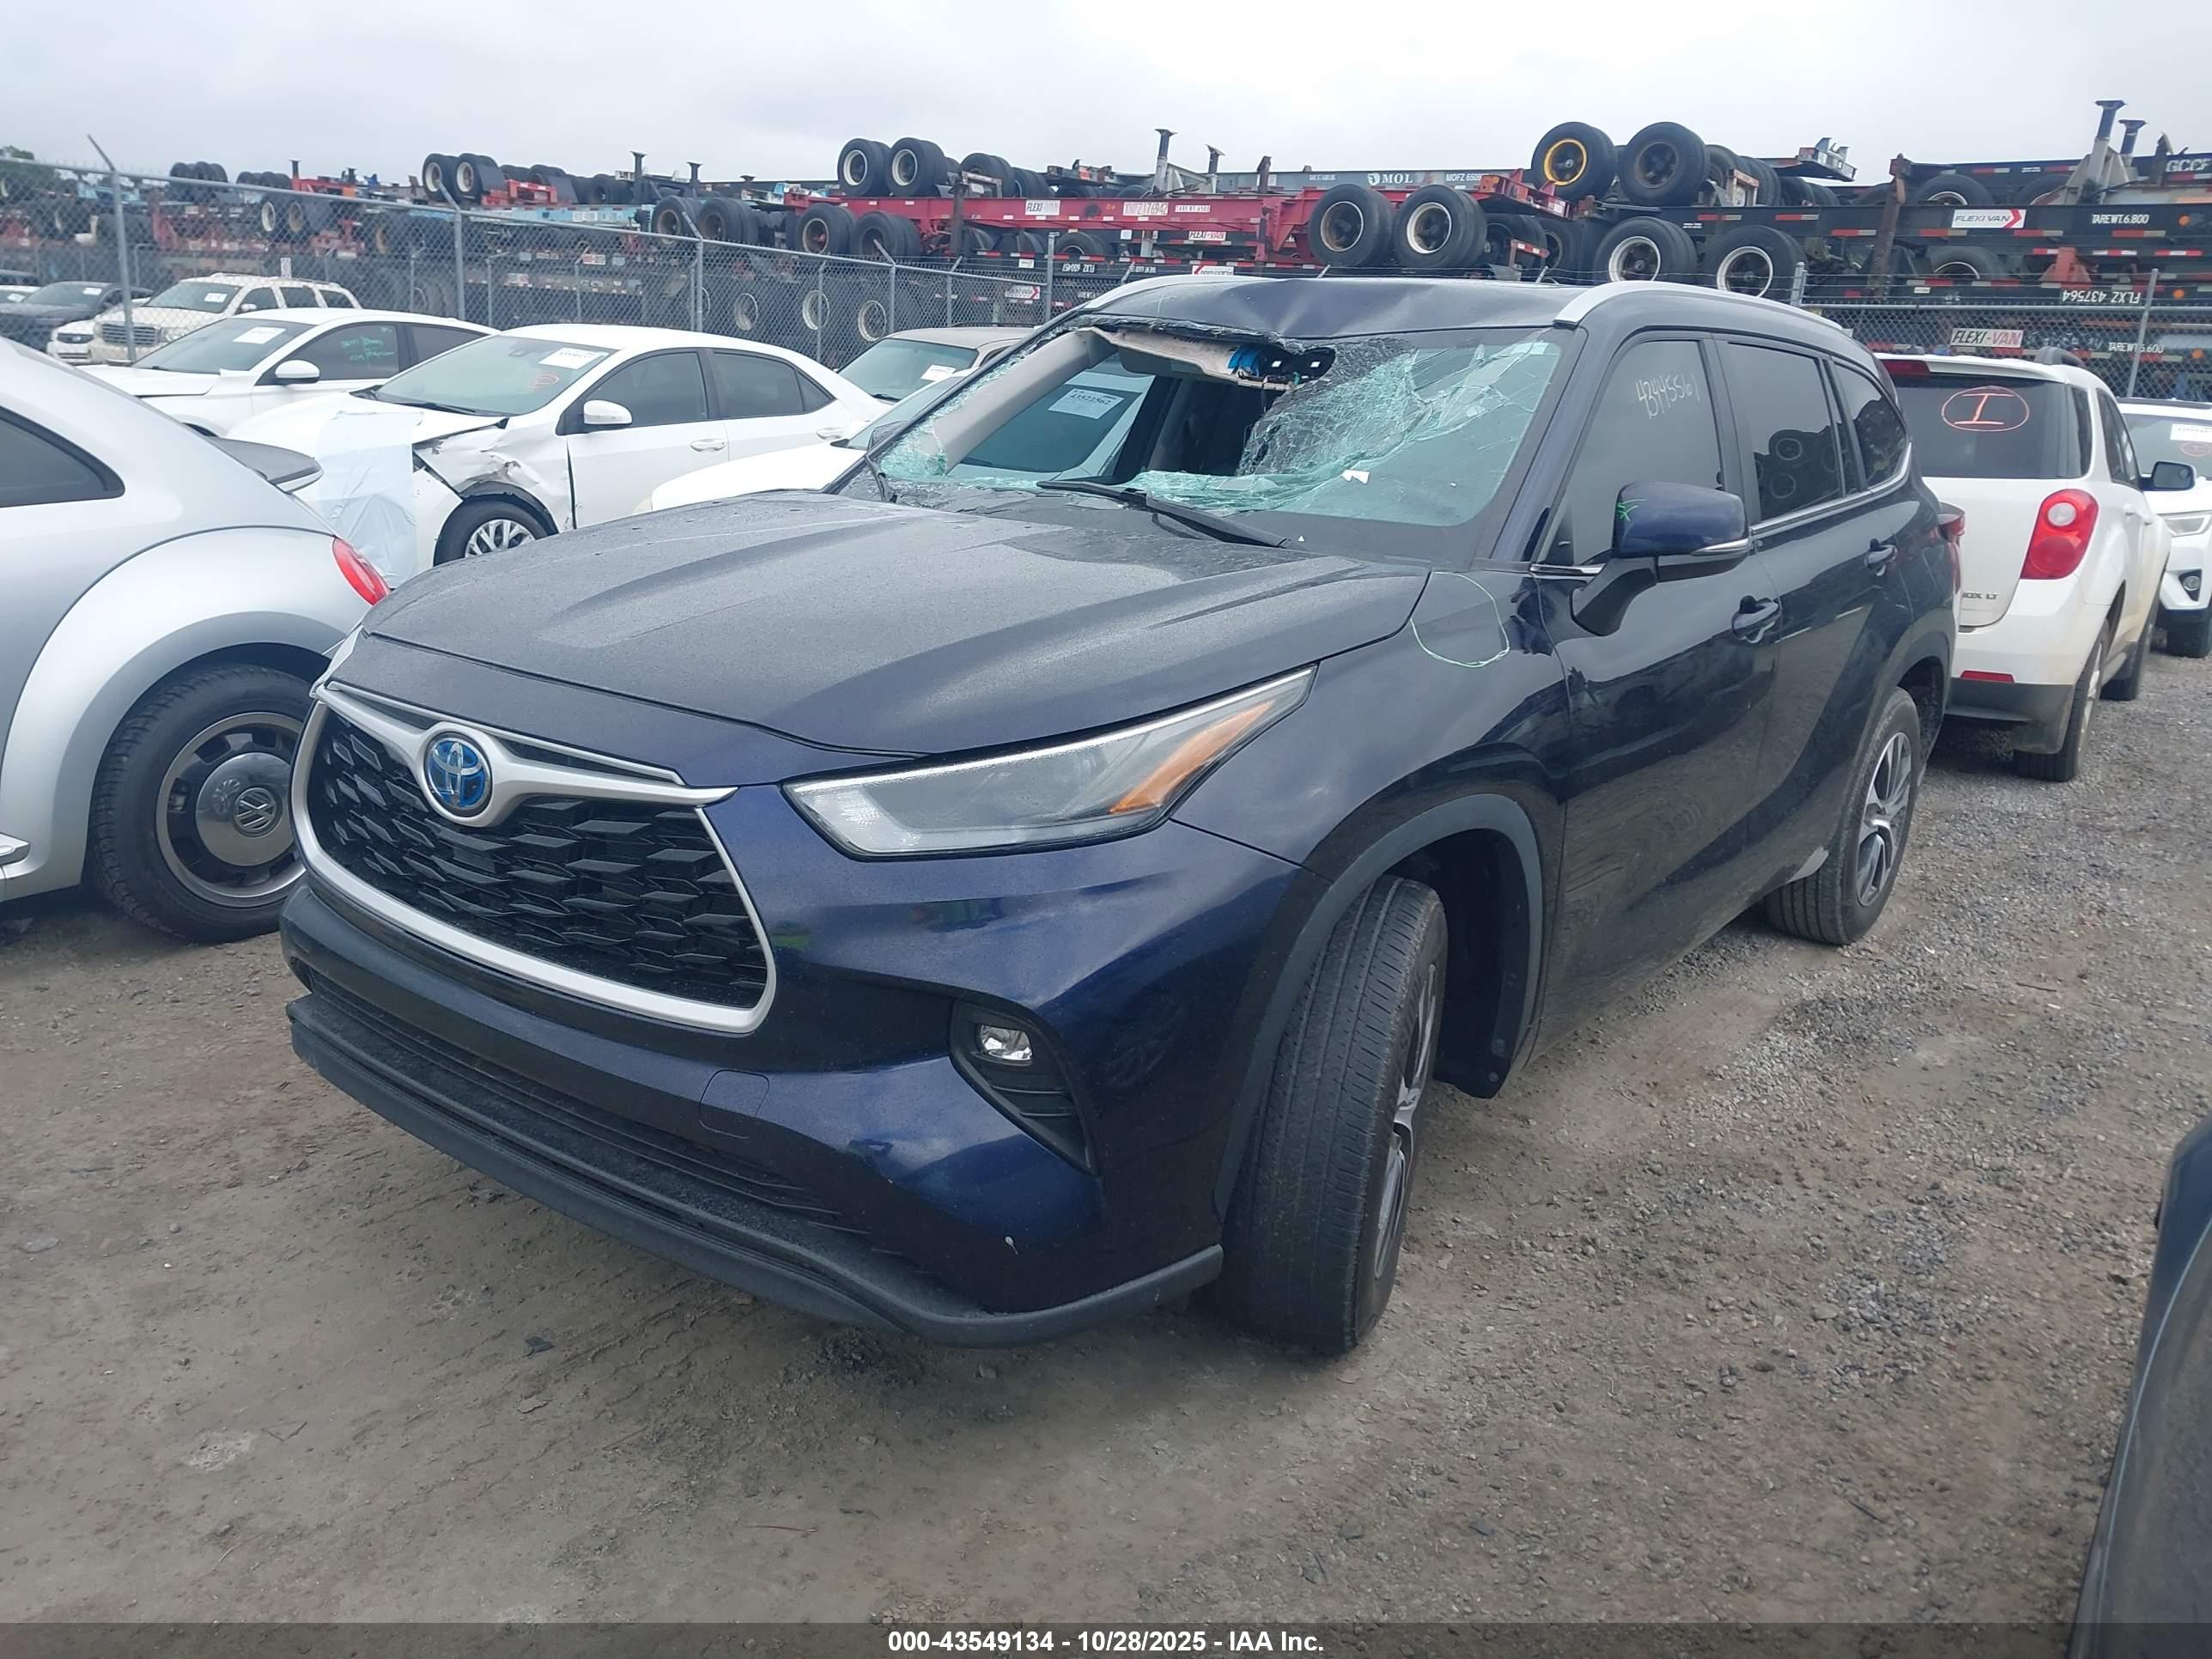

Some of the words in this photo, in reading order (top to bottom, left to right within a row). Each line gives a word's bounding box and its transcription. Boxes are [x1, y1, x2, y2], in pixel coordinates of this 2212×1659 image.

[1381, 173, 1413, 184] MOL
[2062, 289, 2107, 303] 437564
[2111, 291, 2142, 304] FLXZ
[1952, 330, 2021, 345] FLEXI-VAN
